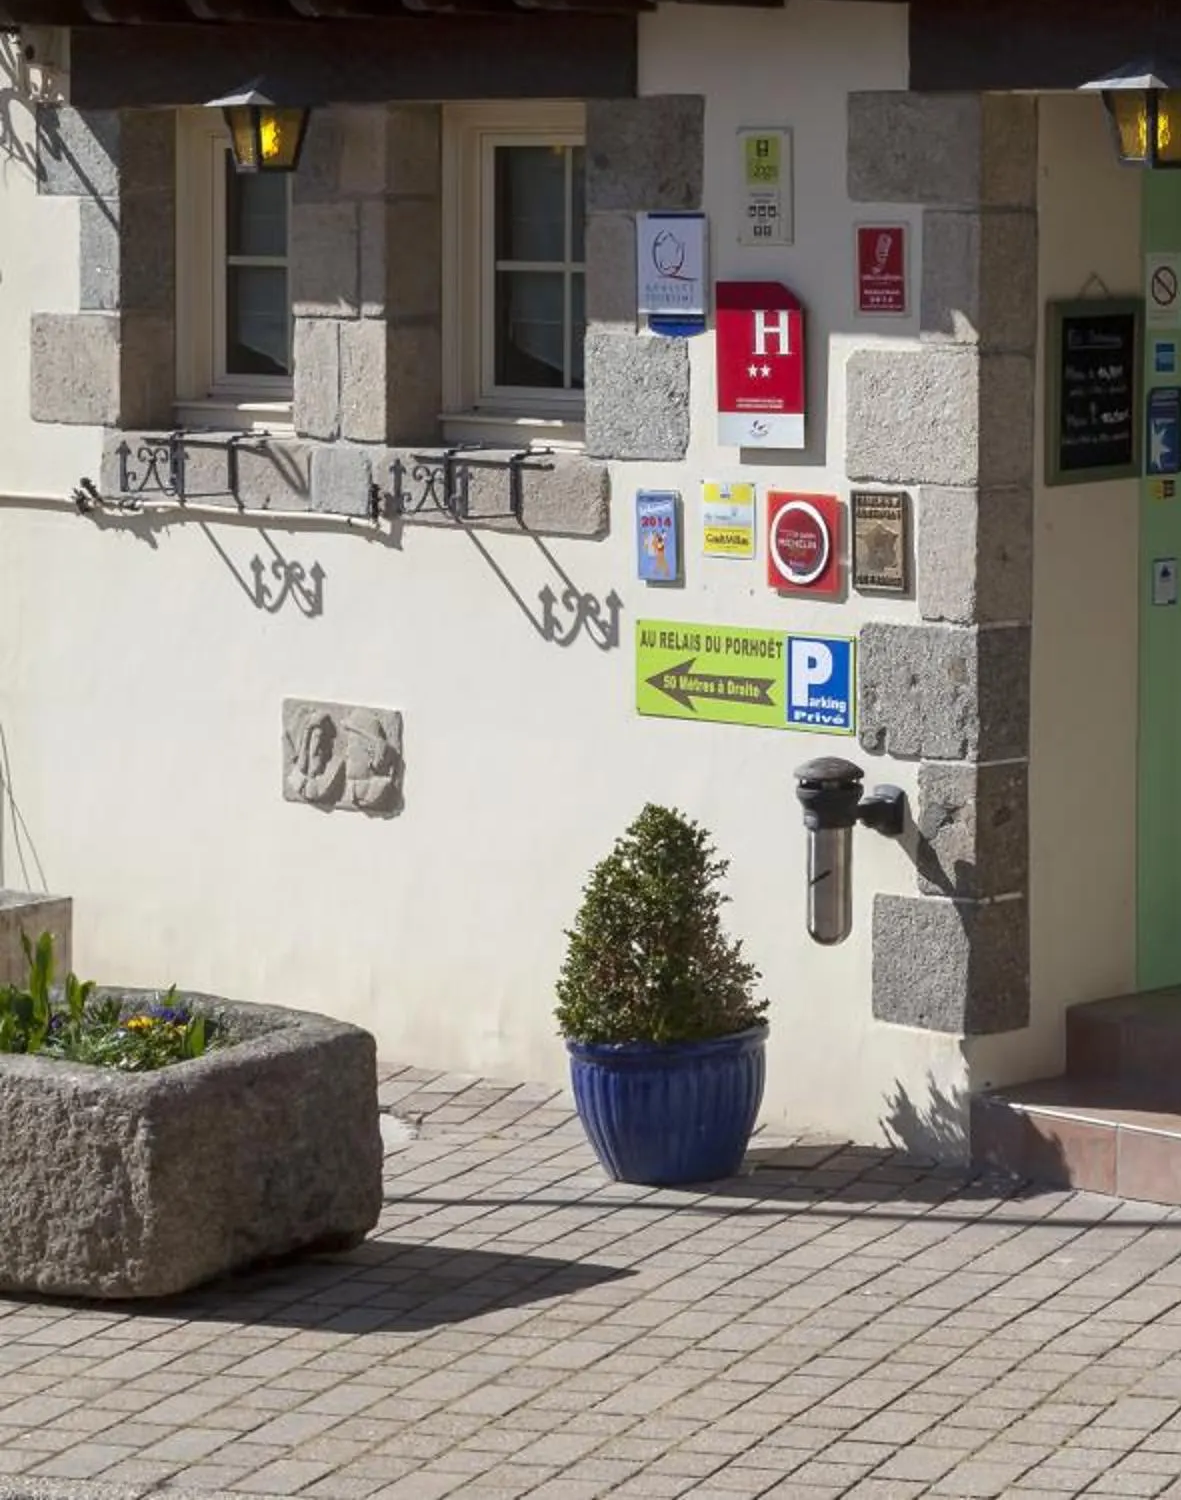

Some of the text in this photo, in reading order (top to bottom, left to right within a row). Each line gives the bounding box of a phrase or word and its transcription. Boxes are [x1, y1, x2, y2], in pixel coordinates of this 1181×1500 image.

[751, 309, 792, 356] H
[640, 515, 672, 529] 2014
[640, 630, 656, 648] AU
[659, 631, 701, 652] RELAIS
[705, 635, 721, 653] DU
[663, 674, 677, 689] 50
[727, 680, 760, 698] Droite
[793, 710, 845, 725] Privé
